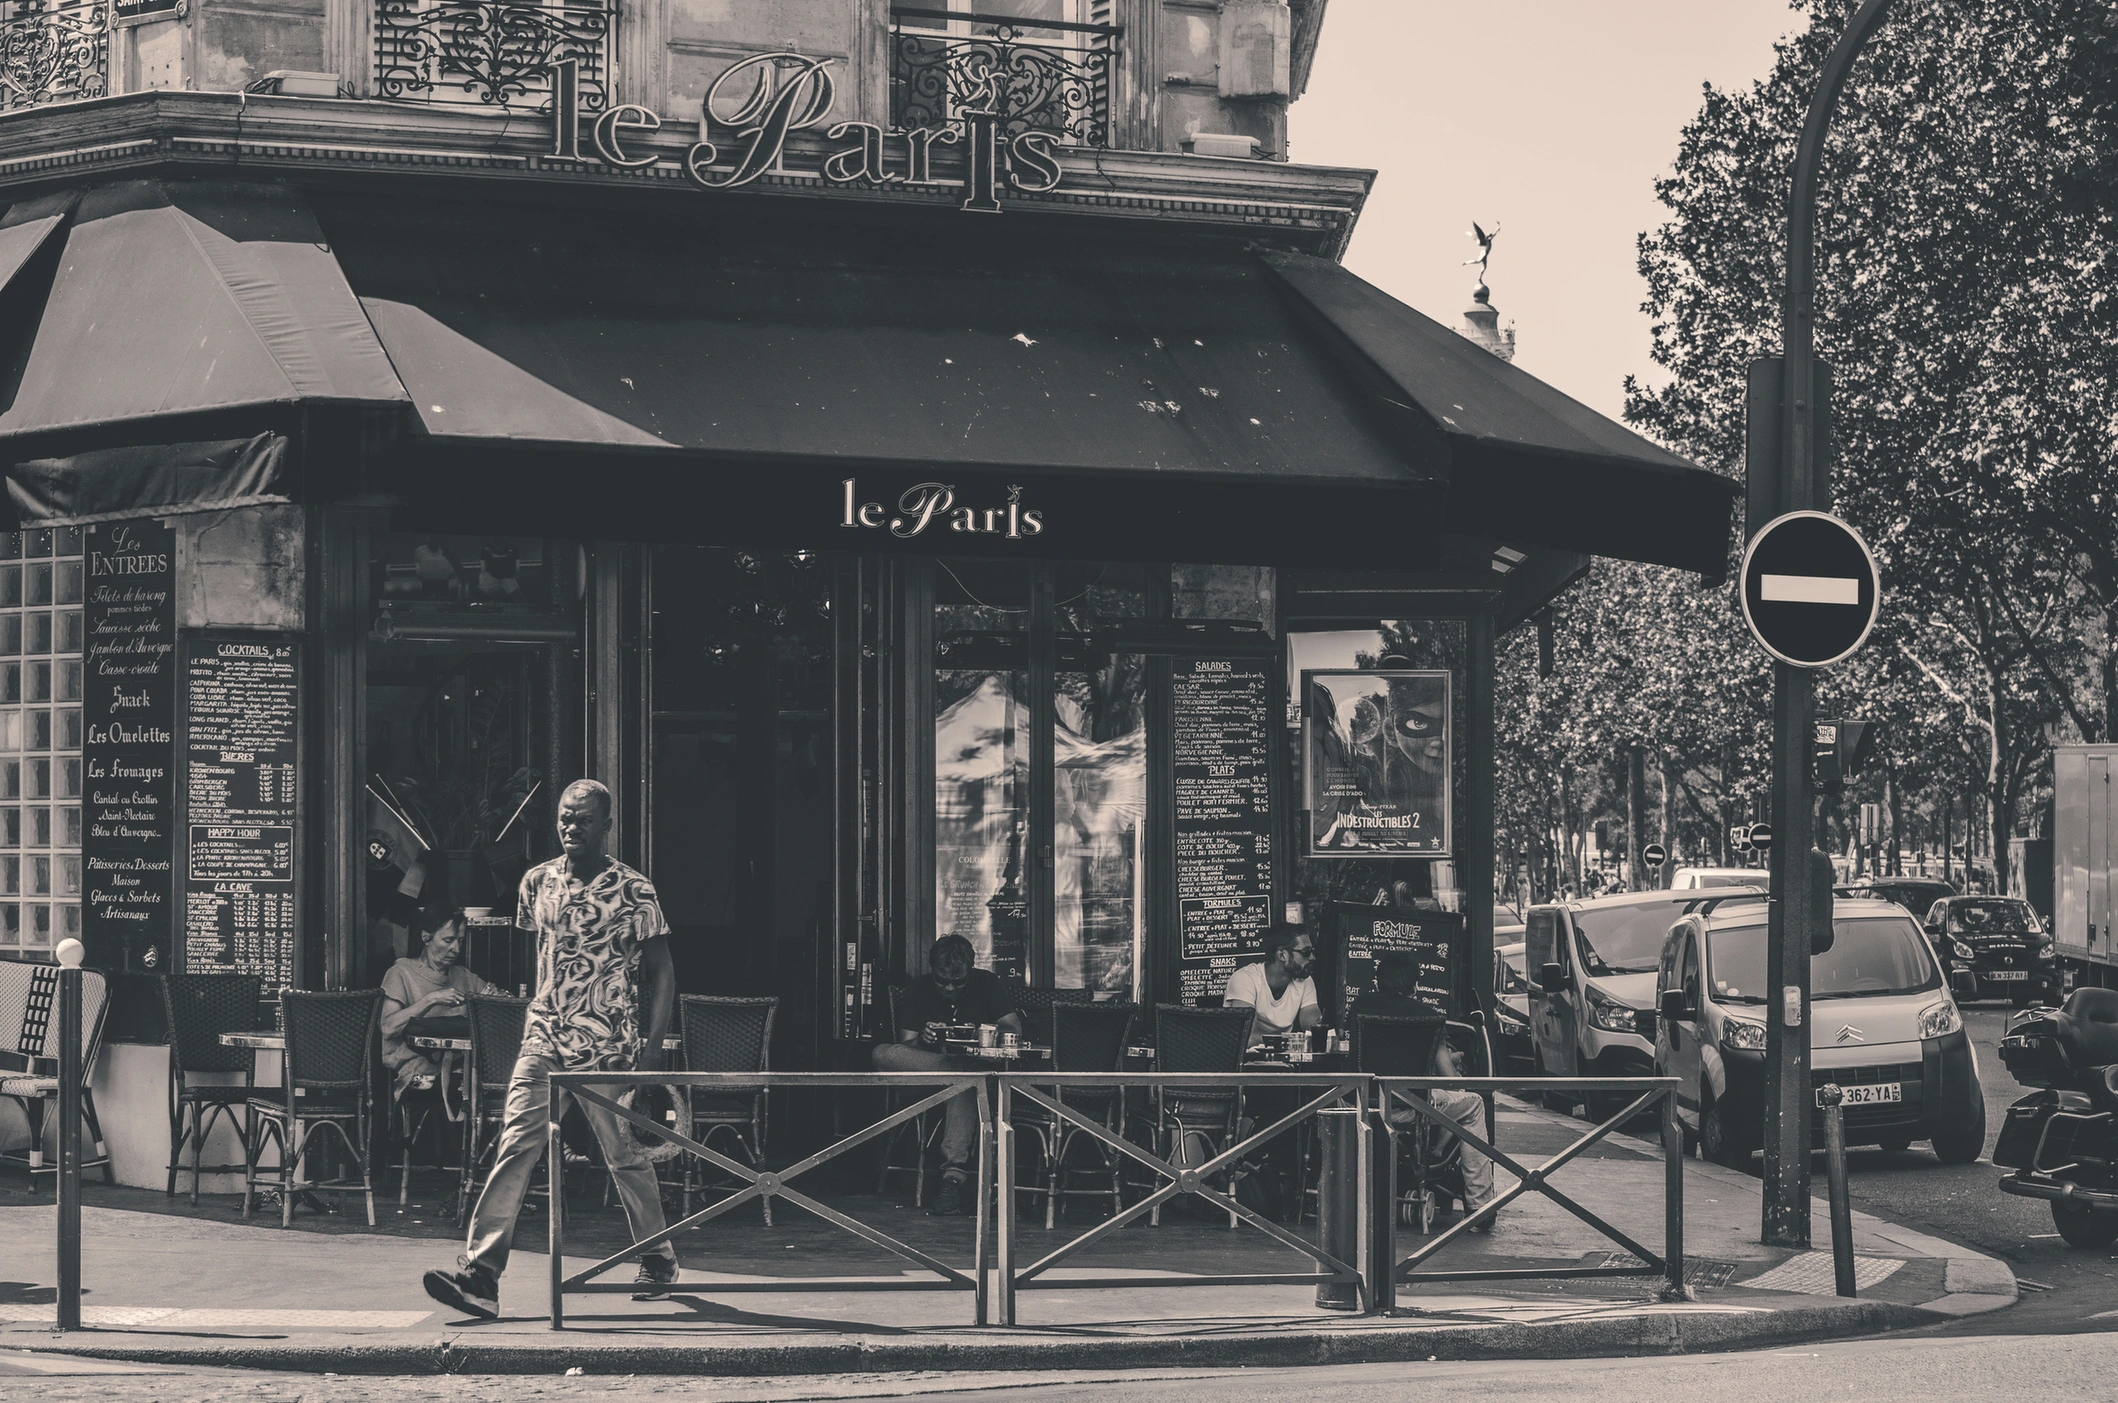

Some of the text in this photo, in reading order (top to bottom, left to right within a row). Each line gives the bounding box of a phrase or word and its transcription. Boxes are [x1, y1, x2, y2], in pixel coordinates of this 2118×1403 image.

[544, 52, 1066, 213] le Paris
[840, 478, 1043, 539] le Paris
[111, 527, 141, 555] Les
[91, 551, 168, 576] ENTREES
[123, 587, 134, 602] de
[217, 644, 269, 656] COCKTAILS
[1195, 661, 1232, 670] SALADES
[110, 685, 151, 713] Snack
[87, 722, 170, 744] Les Omelettes
[87, 758, 105, 778] Les
[1208, 765, 1235, 775] PLATS
[93, 790, 119, 804] Cantal
[1337, 811, 1420, 828] INDESTRUCTIBLES 2
[91, 823, 110, 837] Bleu
[208, 828, 261, 837] HAPPY HOUR
[134, 857, 170, 871] Desserts
[111, 873, 141, 886] Maison
[229, 883, 253, 891] CAVE
[91, 888, 117, 906] Glaces
[127, 890, 161, 903] Sorbets
[1210, 958, 1237, 967] SNAKS
